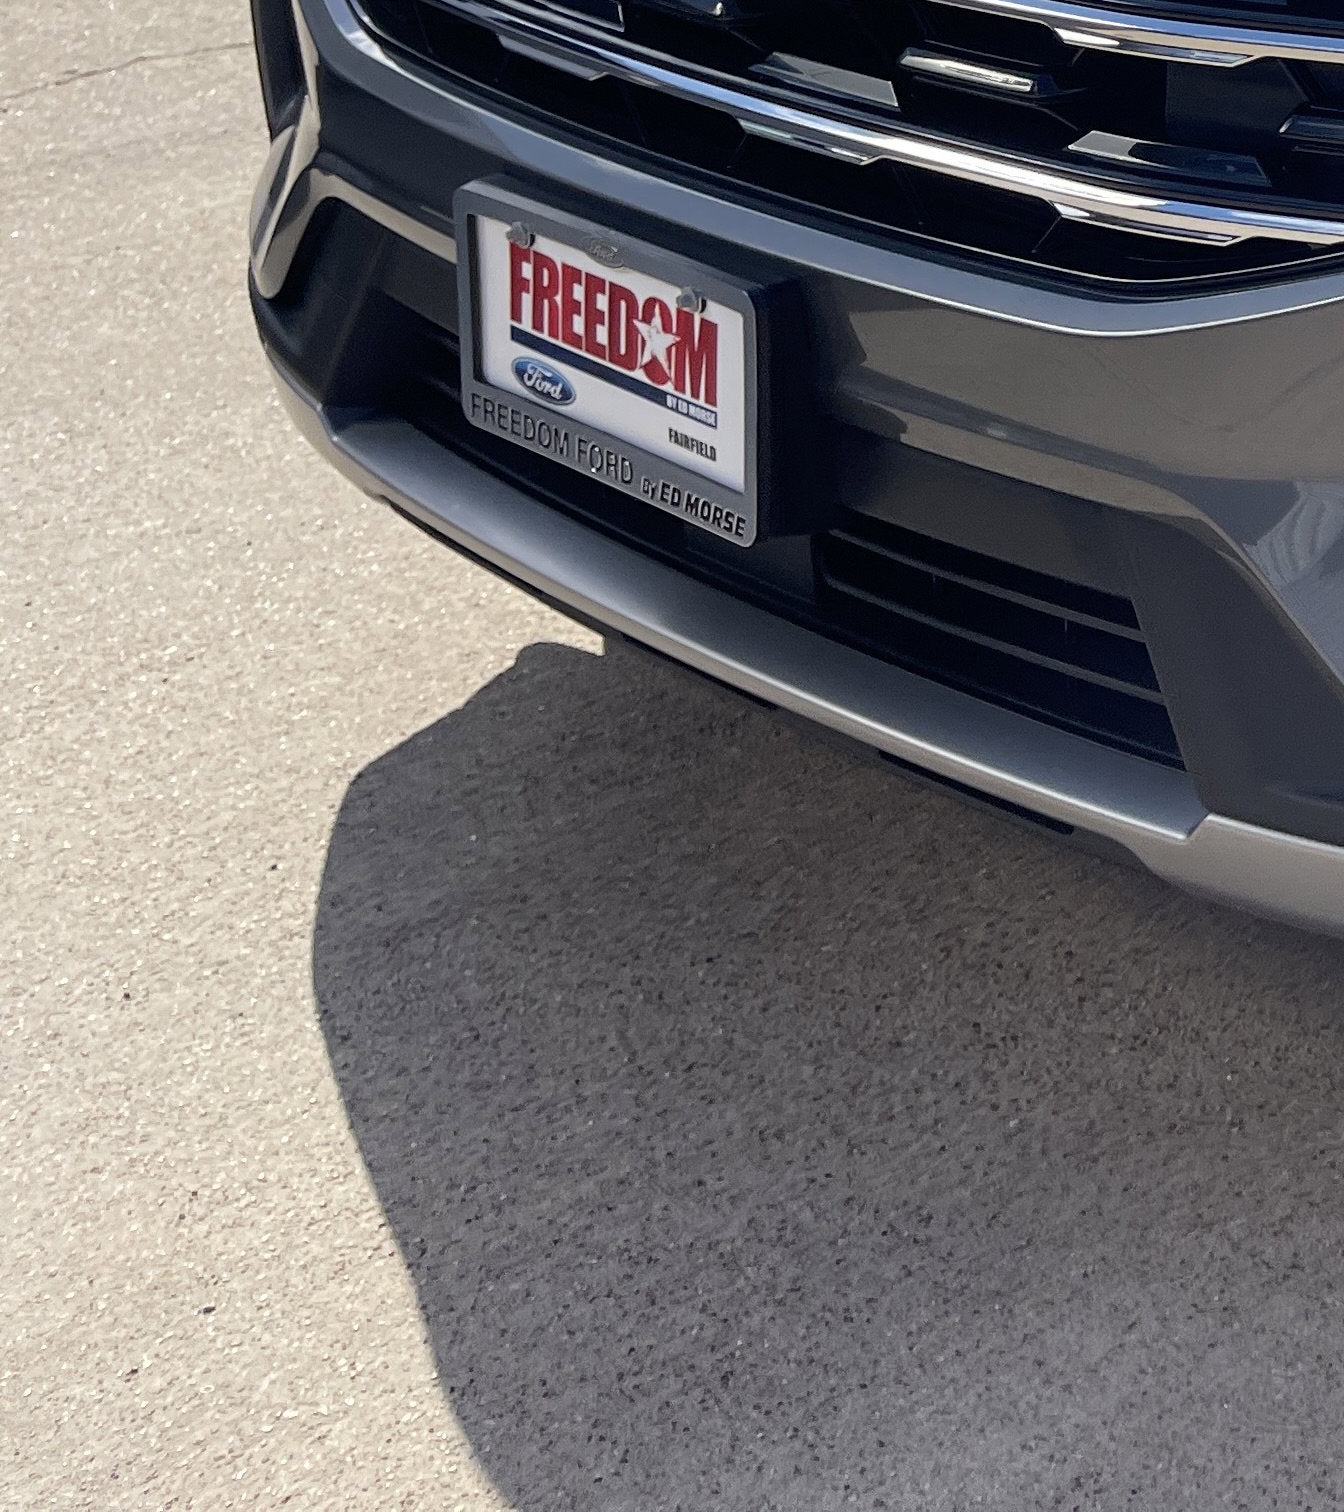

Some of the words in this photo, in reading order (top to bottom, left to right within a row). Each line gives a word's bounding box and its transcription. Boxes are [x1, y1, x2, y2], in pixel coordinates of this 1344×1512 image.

[509, 239, 719, 408] FREEDOM
[522, 363, 563, 401] Ford
[470, 392, 570, 458] FREEDOM
[574, 437, 634, 484] FORD
[660, 482, 682, 507] ED
[685, 491, 747, 537] MORSE
[668, 426, 717, 462] FAIRFIELD
